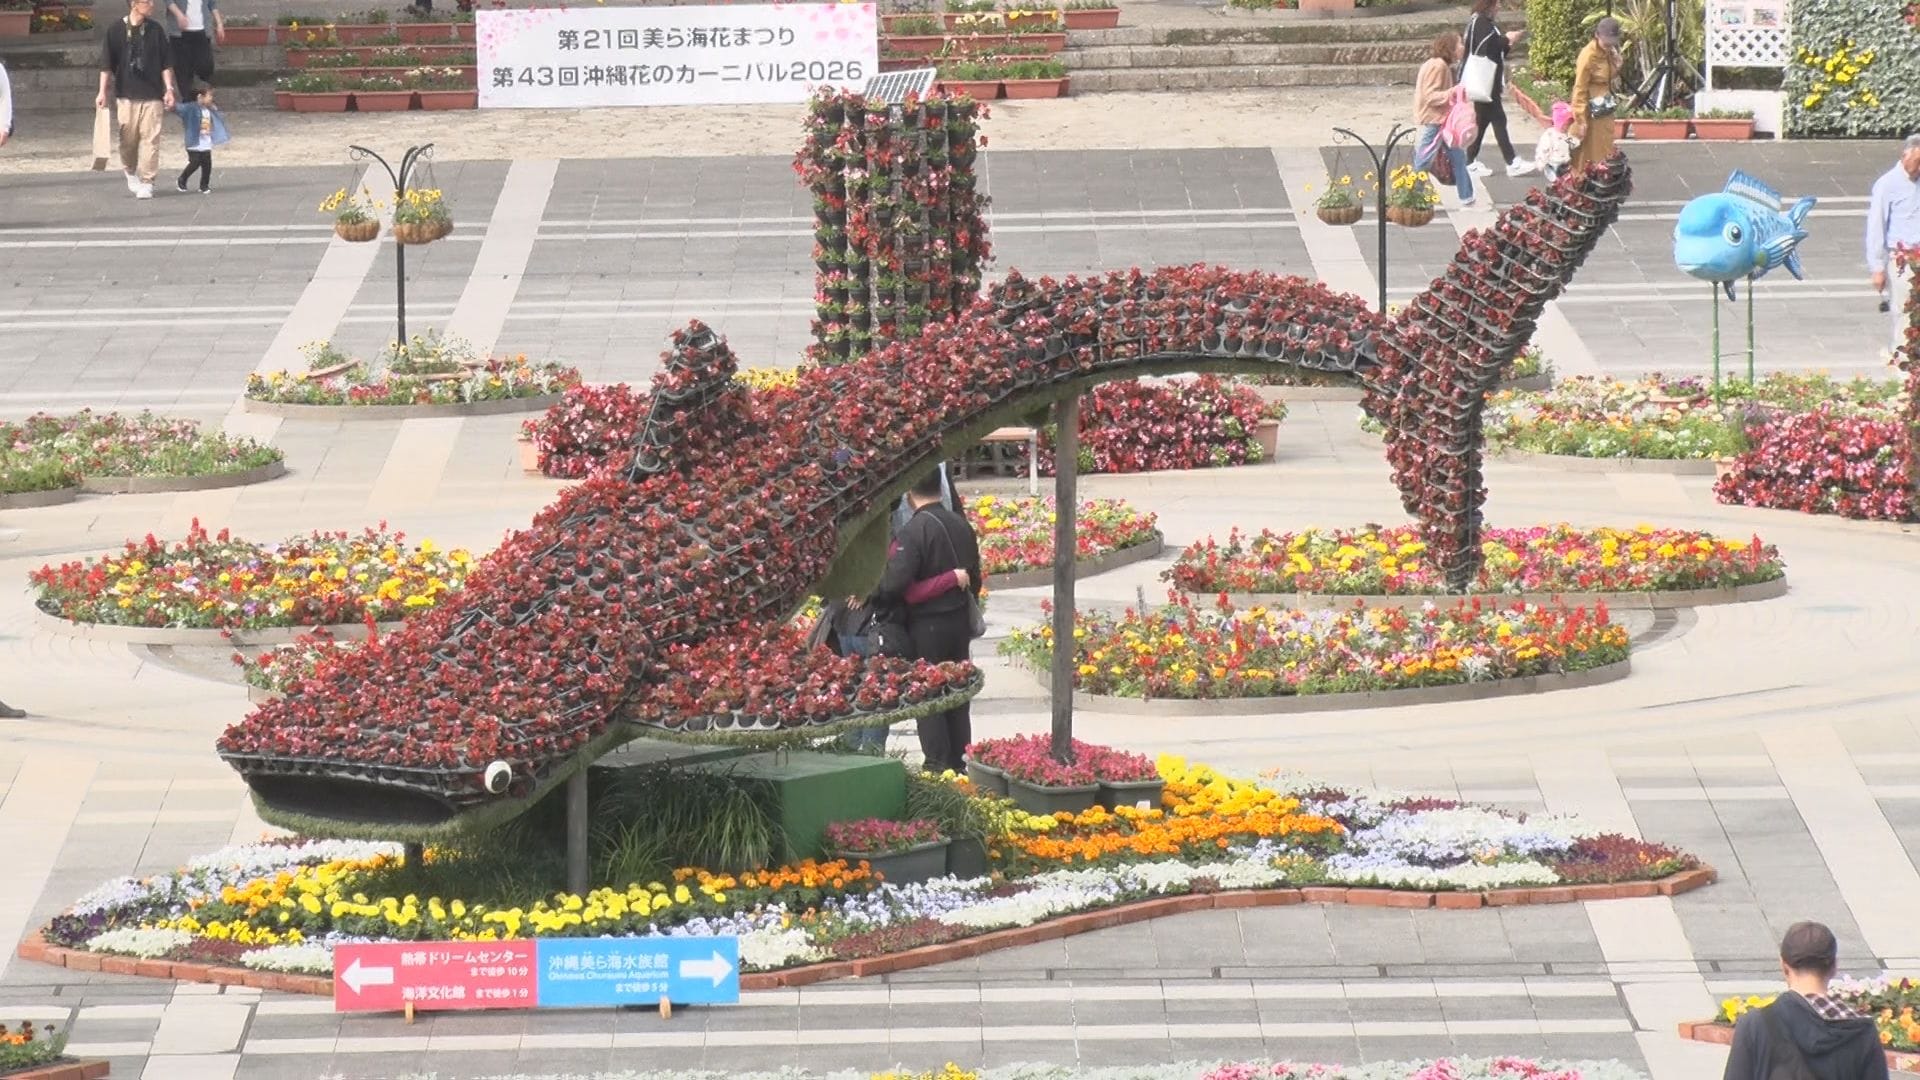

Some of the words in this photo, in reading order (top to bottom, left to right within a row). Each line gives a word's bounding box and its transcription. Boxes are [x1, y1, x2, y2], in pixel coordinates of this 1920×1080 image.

[558, 27, 795, 51] 第21回美ら海花まつり
[492, 61, 863, 88] 第43回沖縄花のカーニバル2026
[401, 952, 528, 966] 熱帯ドリームセンター
[549, 954, 669, 970] 沖縄美ら海水族館
